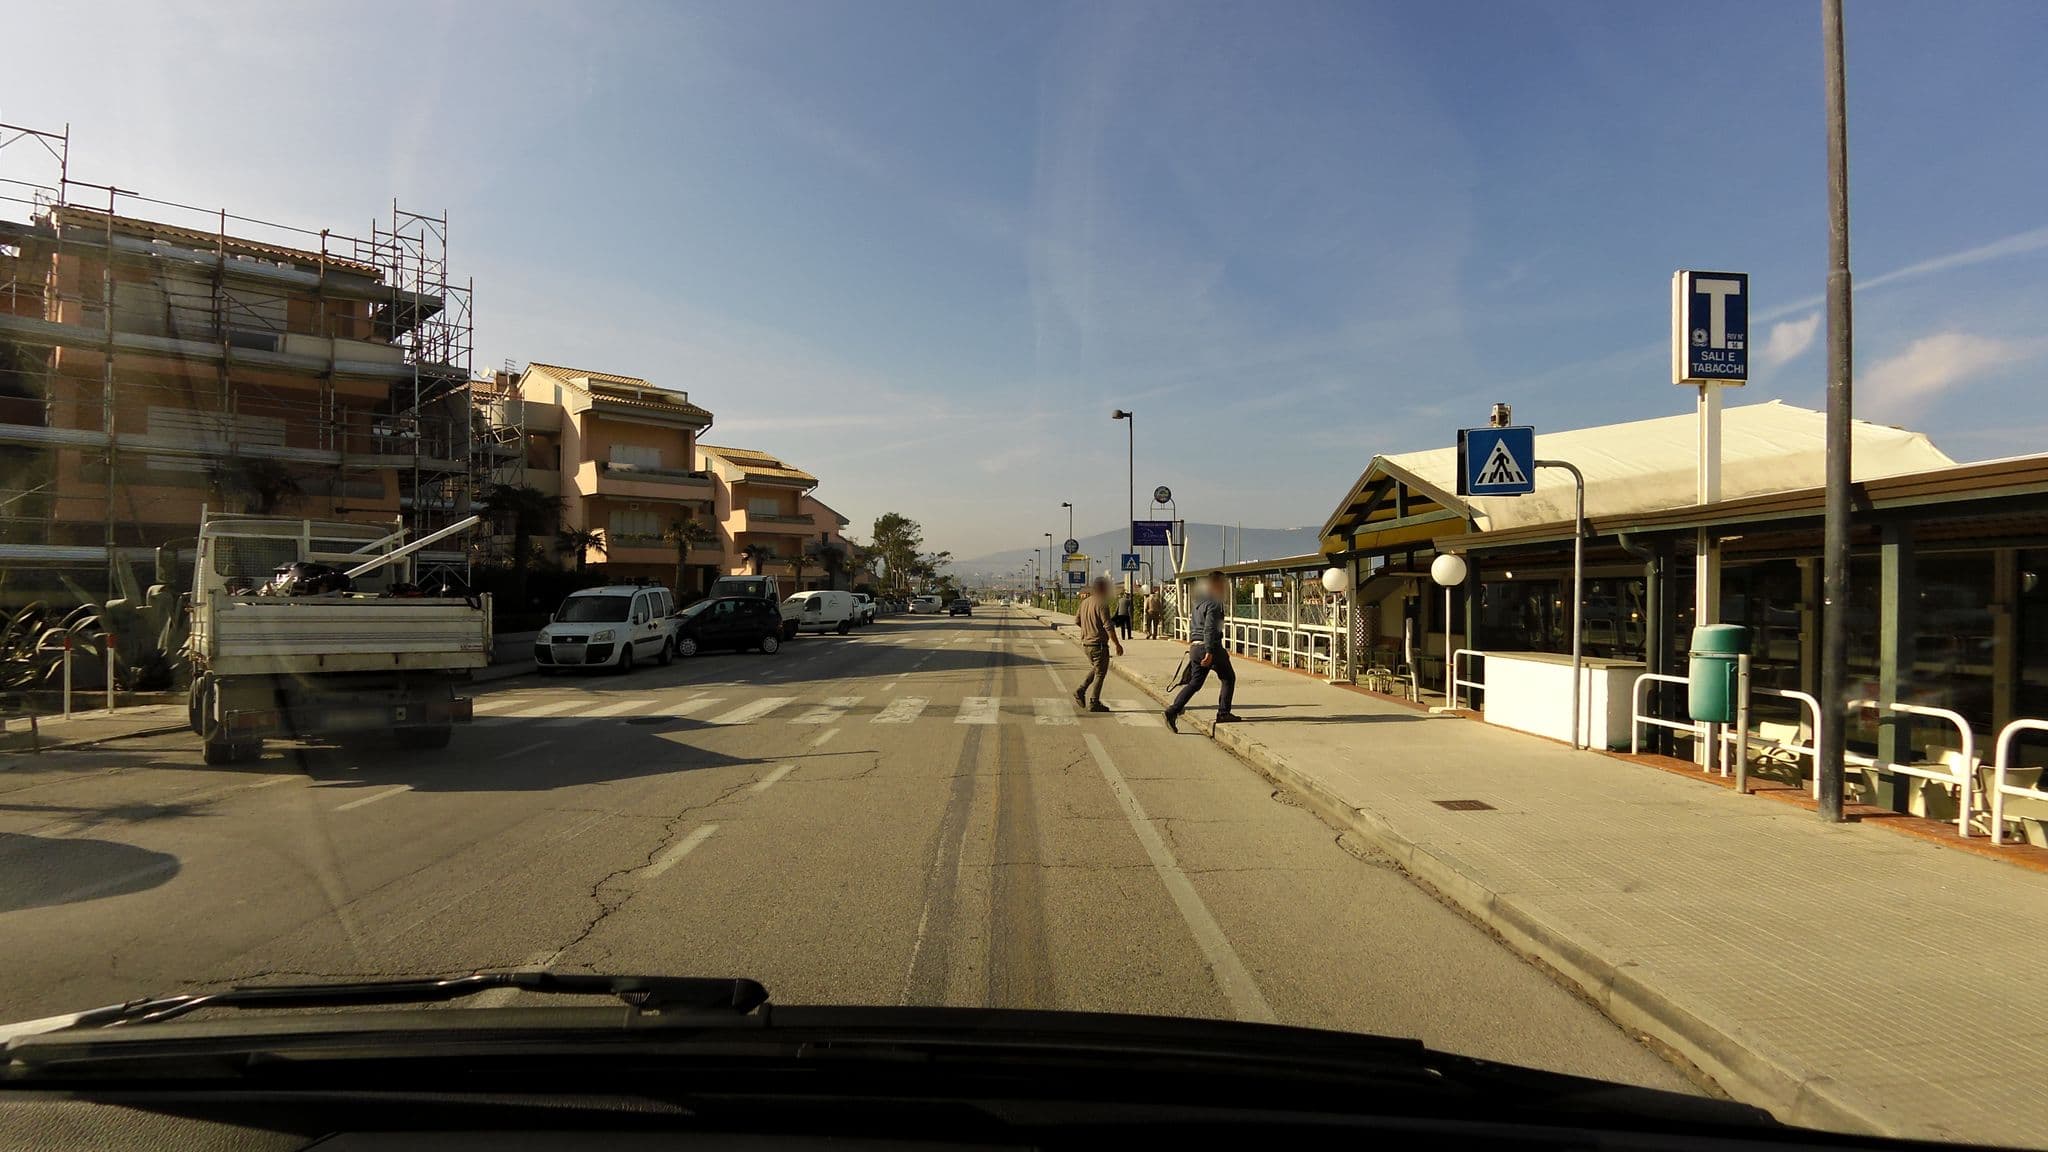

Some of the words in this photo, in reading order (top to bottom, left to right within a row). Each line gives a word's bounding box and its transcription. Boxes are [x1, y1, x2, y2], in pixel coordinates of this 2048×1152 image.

[1695, 279, 1740, 348] T
[1701, 351, 1724, 361] SALI
[1728, 352, 1735, 361] E
[1692, 362, 1744, 374] TABACCHI
